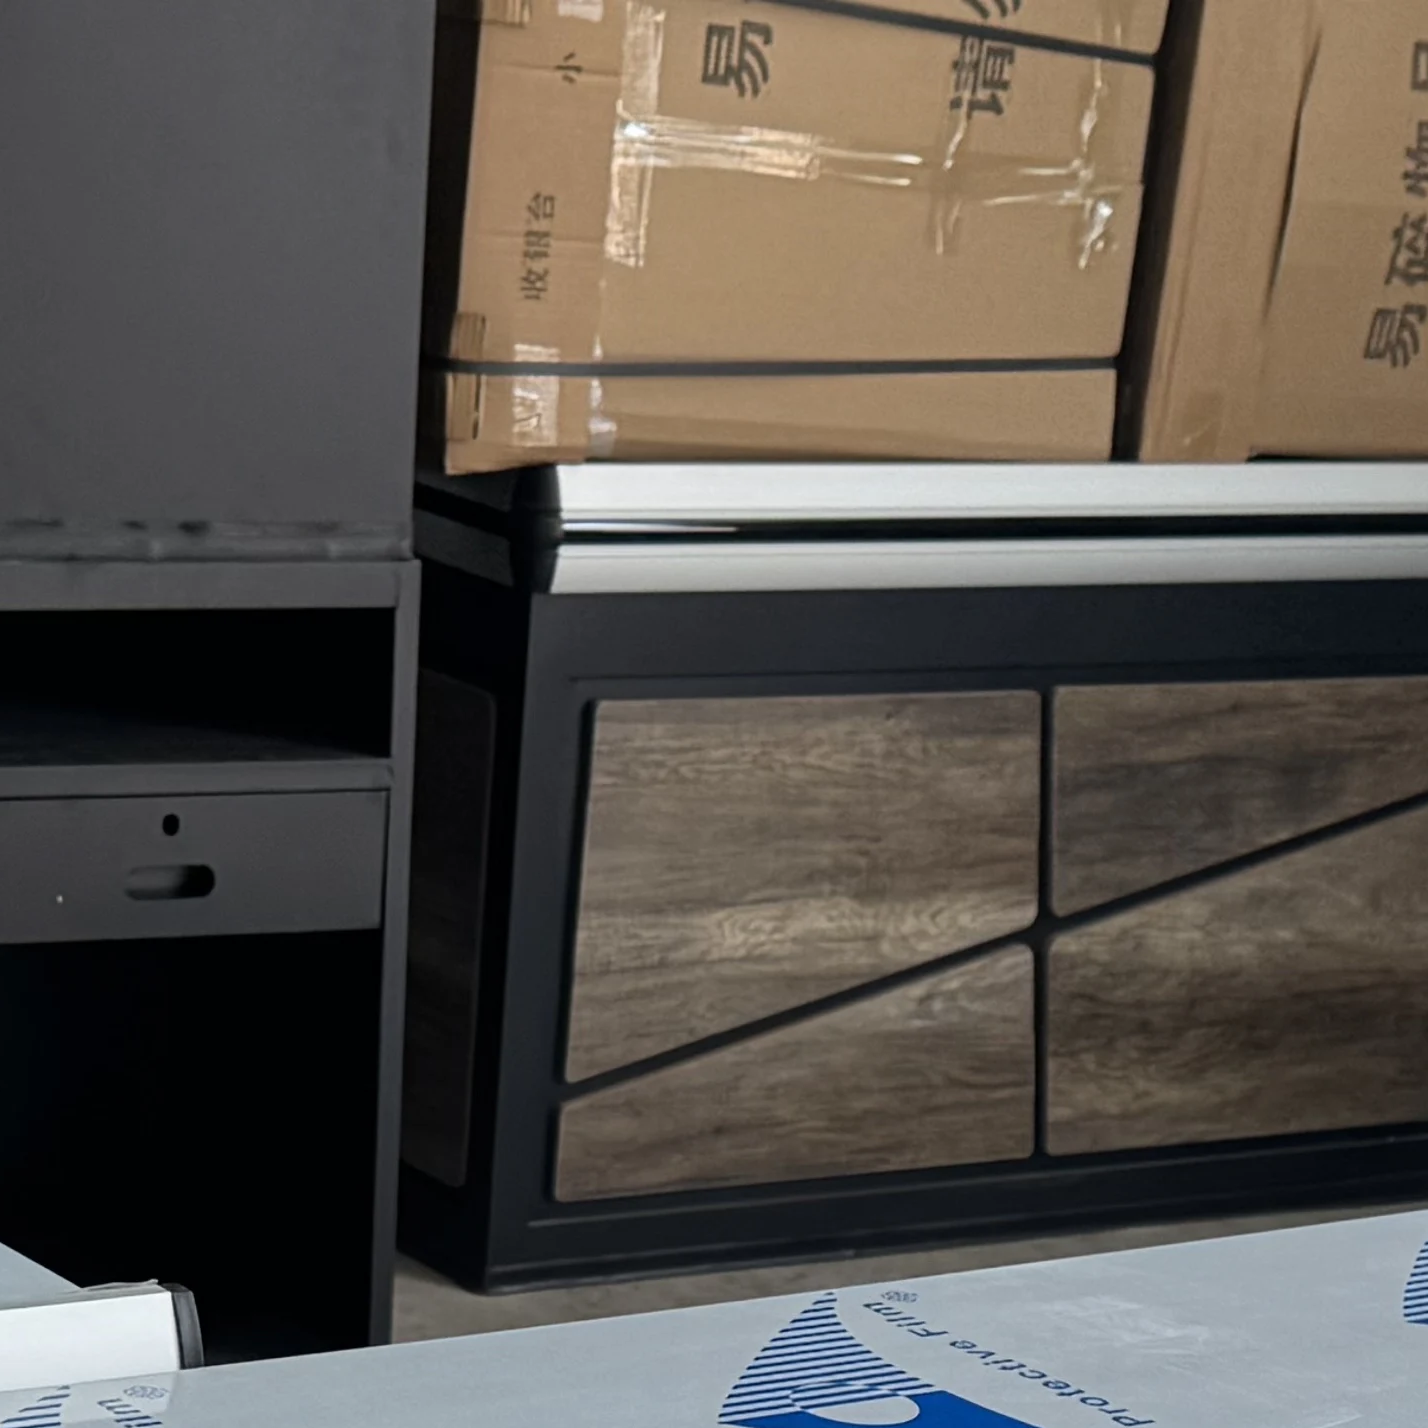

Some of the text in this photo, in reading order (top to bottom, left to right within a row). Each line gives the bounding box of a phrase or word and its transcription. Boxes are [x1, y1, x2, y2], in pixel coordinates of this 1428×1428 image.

[700, 20, 774, 98] 易
[948, 0, 1022, 116] 请
[862, 1300, 949, 1338] Film
[950, 1340, 1156, 1428] Protective
